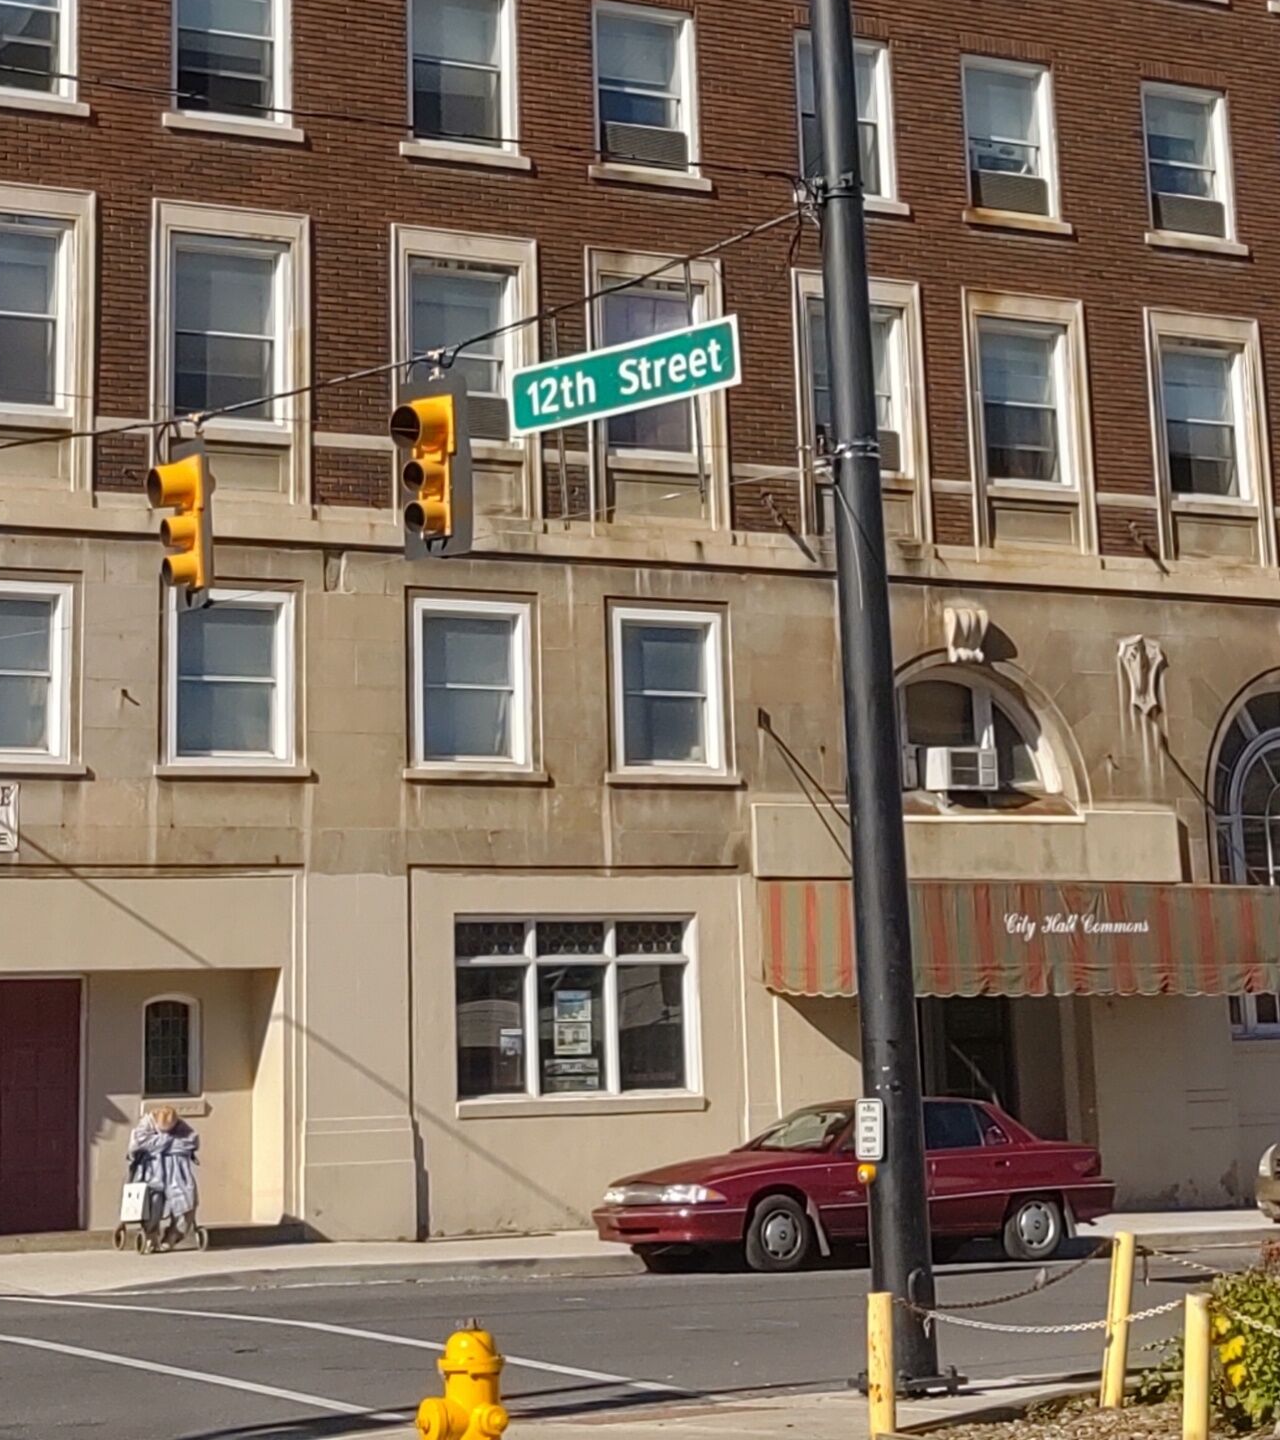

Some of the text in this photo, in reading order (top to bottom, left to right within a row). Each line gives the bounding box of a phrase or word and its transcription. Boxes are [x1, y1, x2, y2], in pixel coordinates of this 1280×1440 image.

[526, 338, 722, 416] 12th Street
[1003, 912, 1150, 942] City Hall Commons
